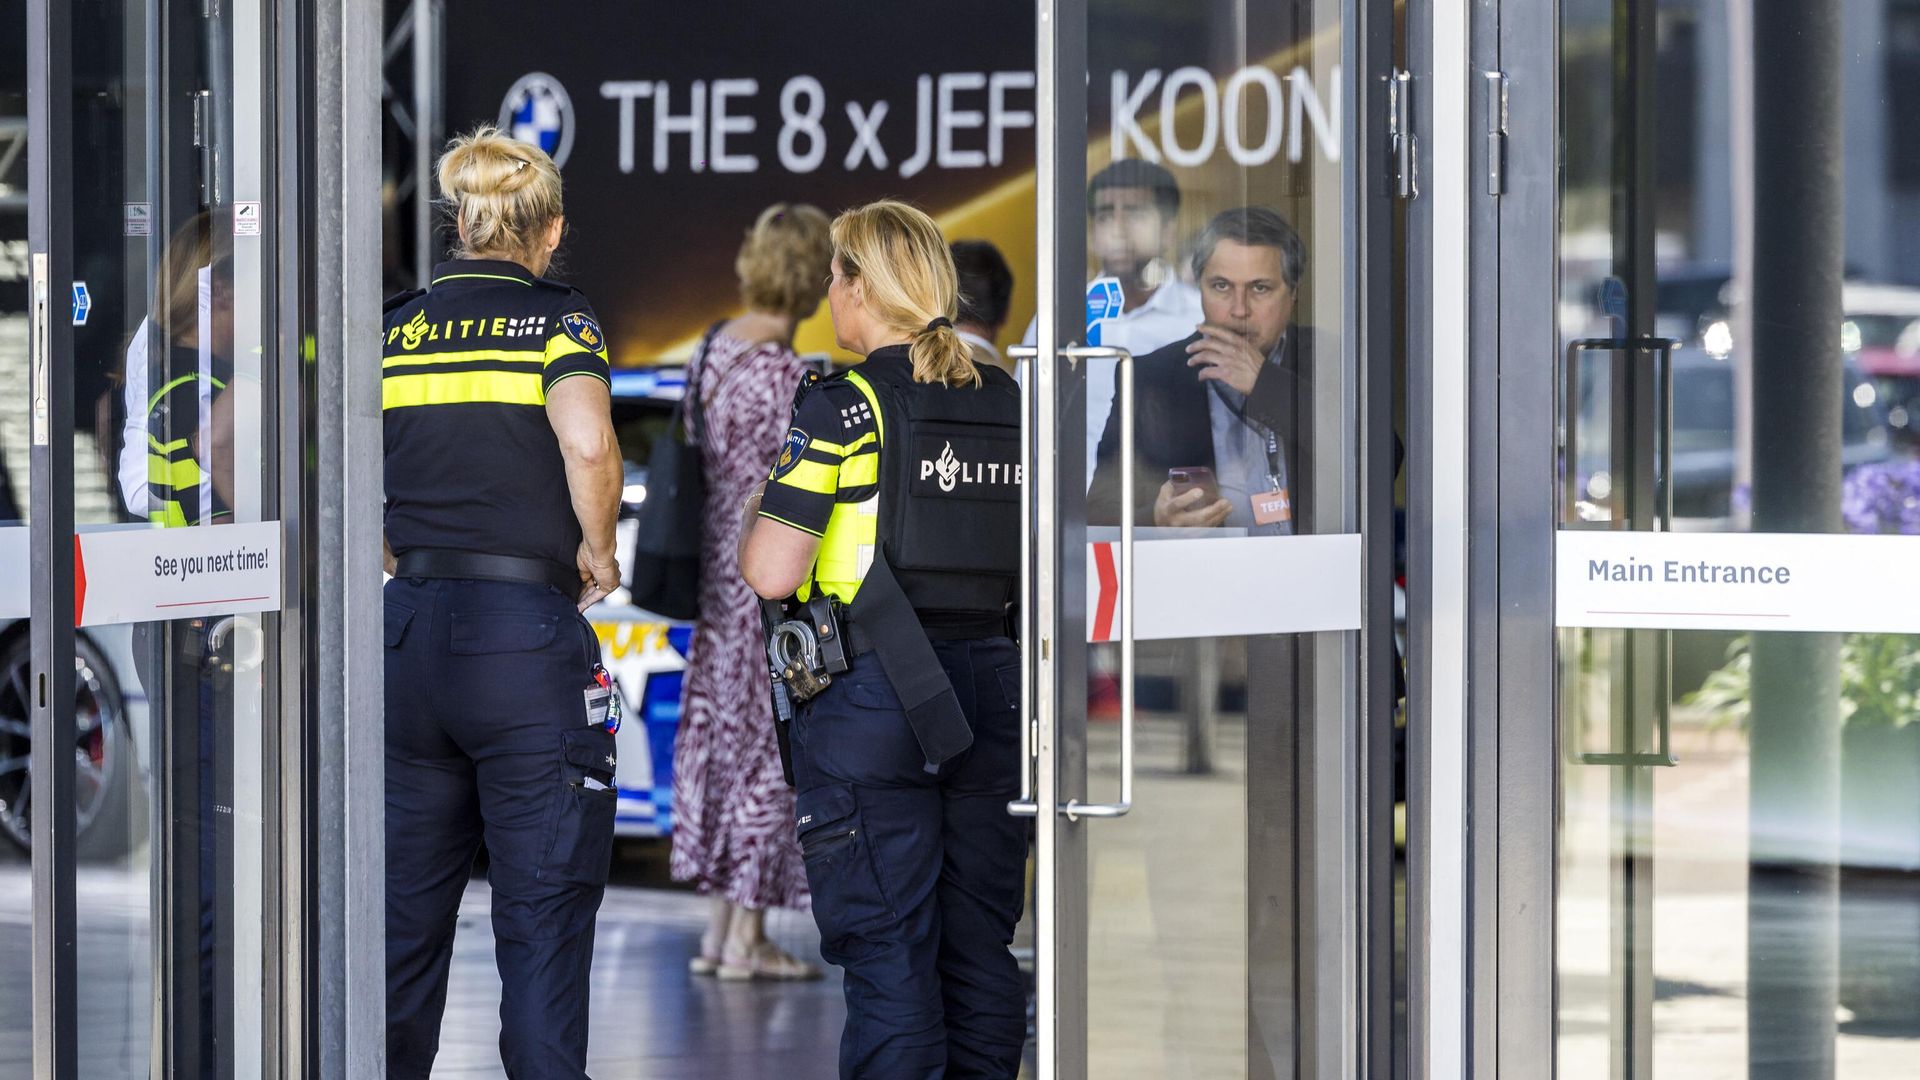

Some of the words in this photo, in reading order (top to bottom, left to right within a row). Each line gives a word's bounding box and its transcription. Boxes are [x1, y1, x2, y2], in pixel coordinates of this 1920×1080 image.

[600, 78, 759, 173] THE
[777, 75, 827, 173] 8
[843, 101, 889, 171] x
[899, 71, 1090, 179] JEF
[388, 309, 507, 350] POLITIE
[920, 441, 1022, 492] POLITIE
[154, 555, 178, 577] See
[181, 556, 203, 582] you
[207, 550, 234, 573] next
[237, 545, 269, 571] time!
[1588, 556, 1653, 582] Main
[1664, 560, 1791, 584] Entrance
